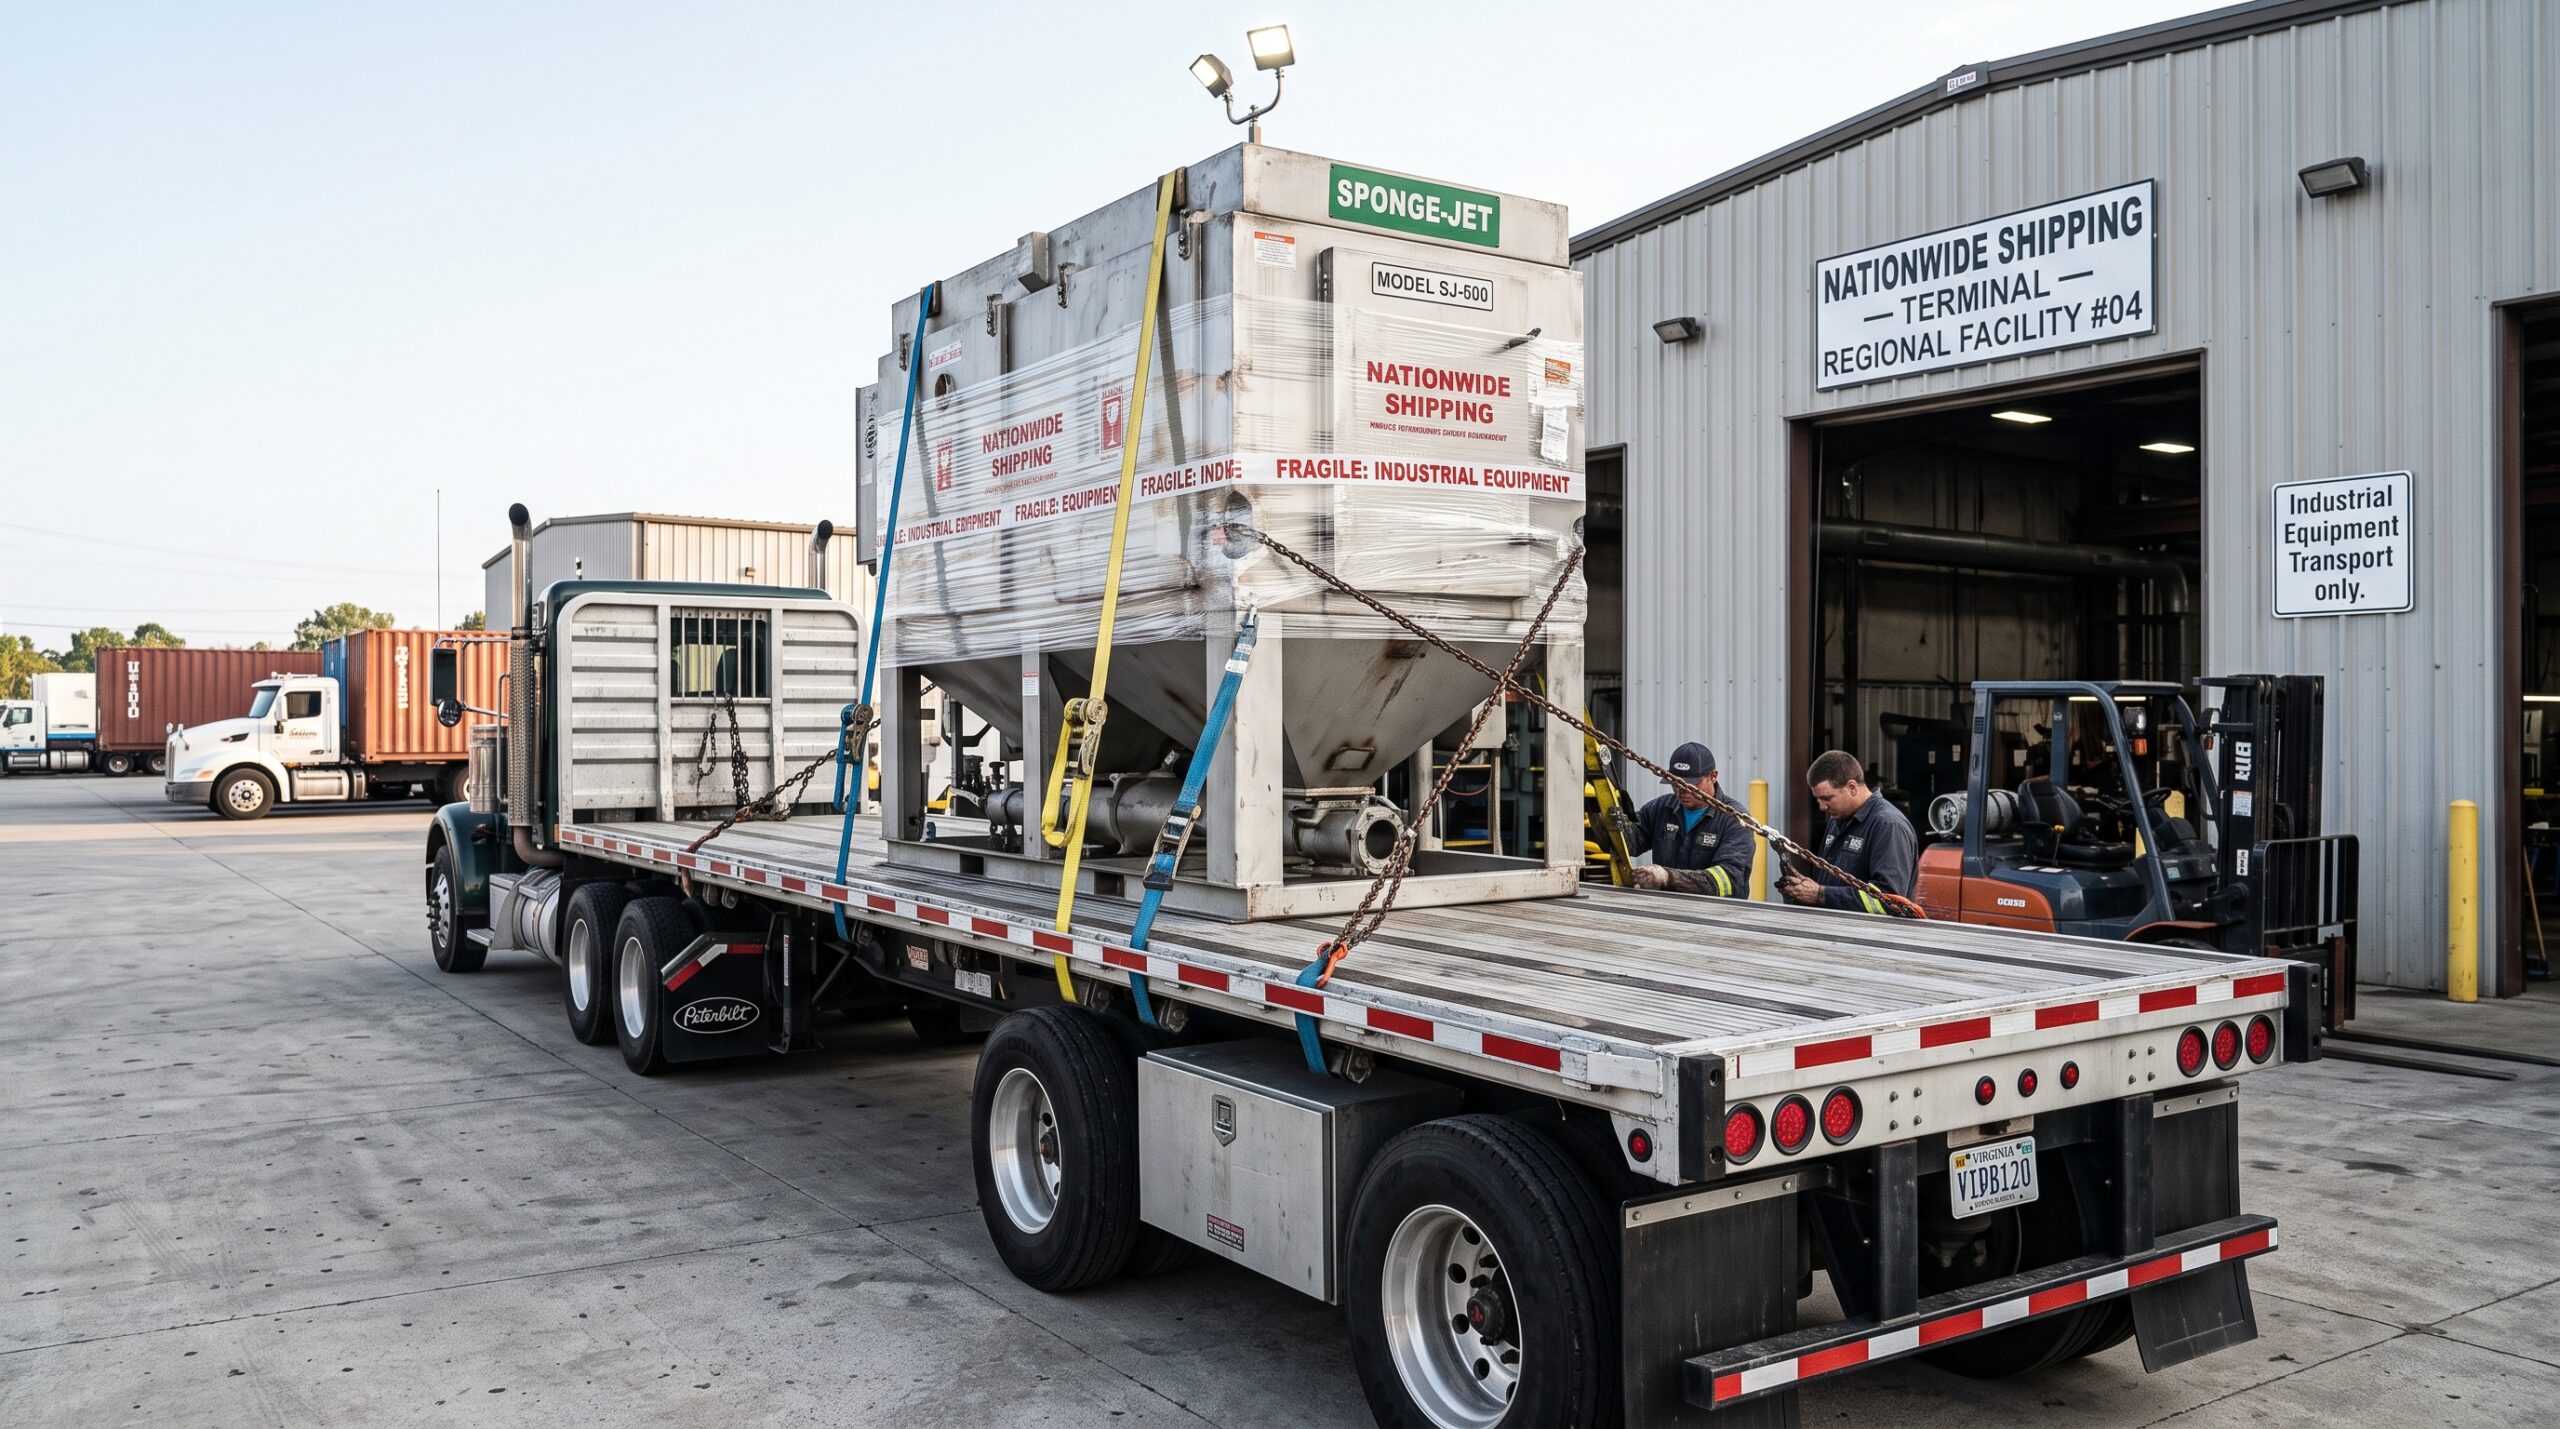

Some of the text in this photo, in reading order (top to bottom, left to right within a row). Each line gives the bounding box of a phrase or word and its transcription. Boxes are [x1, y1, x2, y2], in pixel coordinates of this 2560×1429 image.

[1337, 178, 1493, 232] SPONGE-JET
[1824, 196, 2143, 303] NATIONWIDE SHIPPING
[1377, 271, 1434, 295] MODEL
[1901, 269, 2050, 325] TERMINAL
[1824, 290, 2143, 377] REGIONAL FACILITY #04
[1367, 360, 1511, 398] NATIONWIDE
[1385, 393, 1494, 424] SHIPPING
[982, 412, 1063, 454] NATIONWIDE
[992, 445, 1053, 477] SHIPPING
[1276, 458, 1571, 494] FRAGILE: INDUSTRIAL EQUIPMENT
[1141, 468, 1197, 497] FRAGILE:
[2290, 484, 2392, 515] Industrial
[908, 520, 954, 542] INDUSTRIAL
[2284, 515, 2399, 548] Equipment
[2289, 546, 2393, 574] Transport
[2315, 578, 2365, 604] only.
[683, 1005, 752, 1026] Peterbilt
[1972, 1145, 2015, 1164] VIRGINIA
